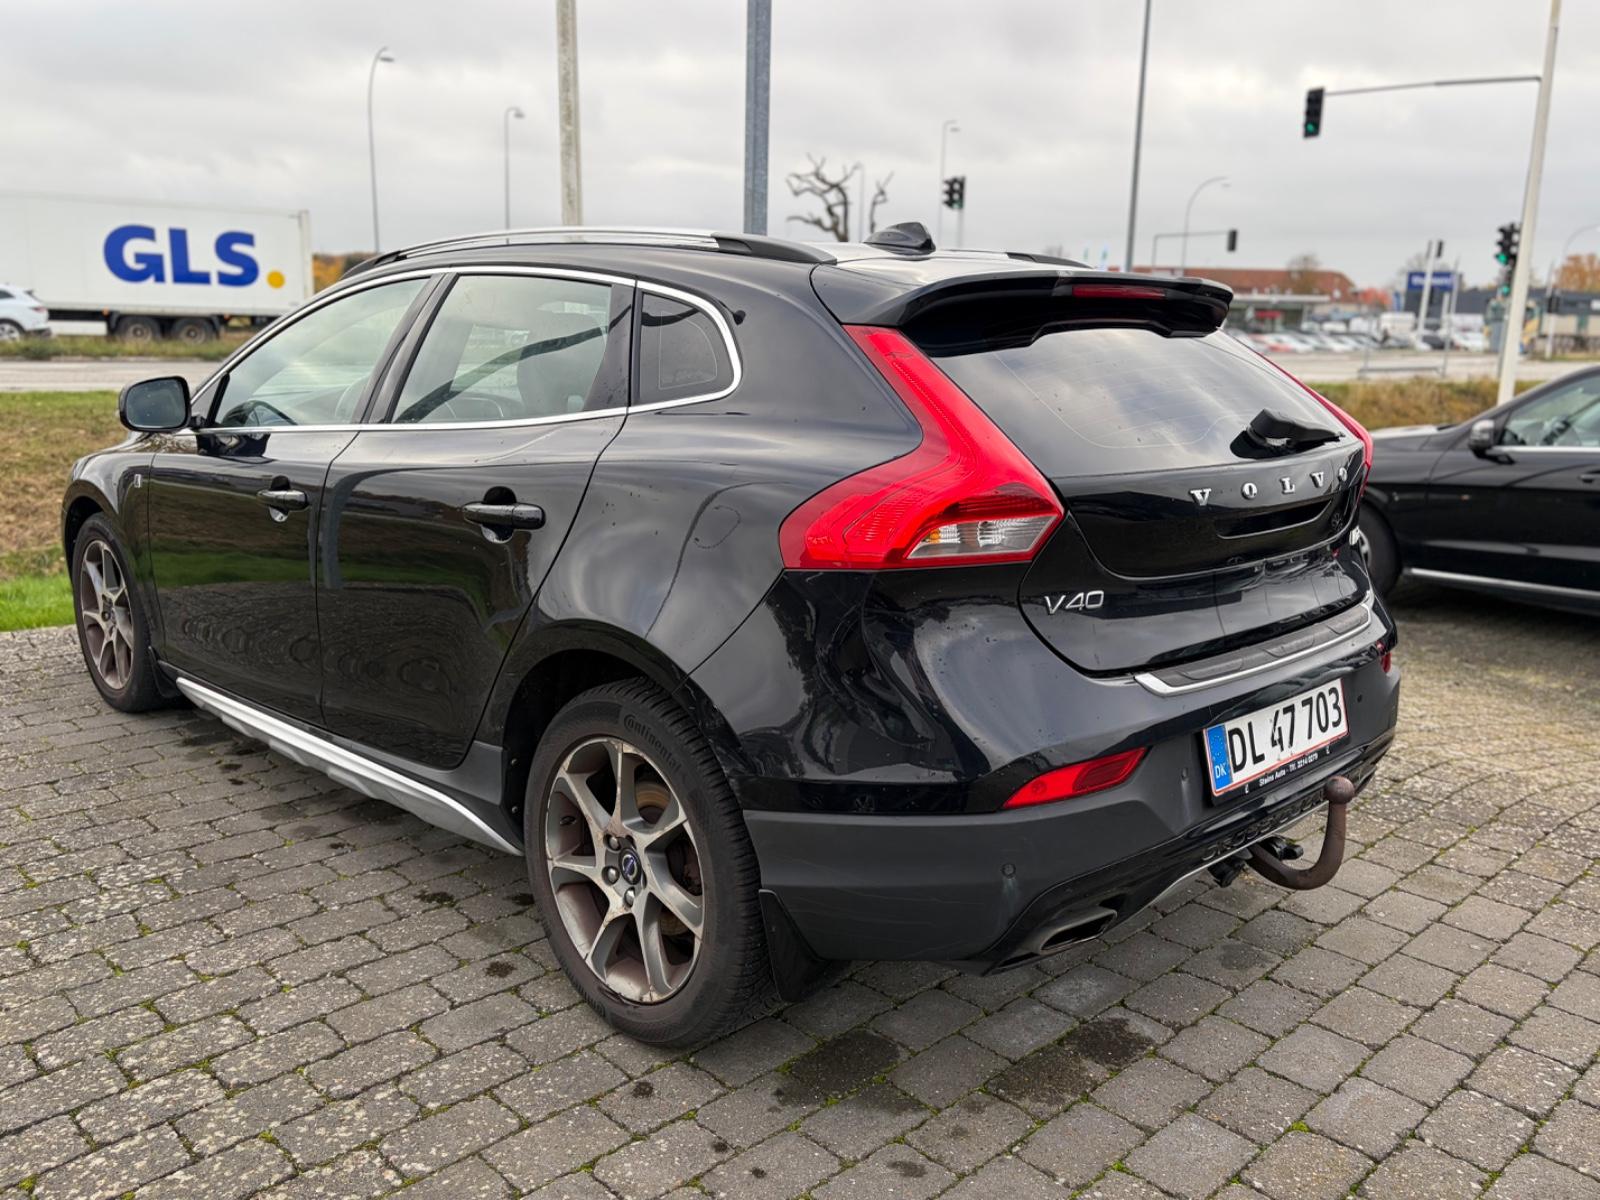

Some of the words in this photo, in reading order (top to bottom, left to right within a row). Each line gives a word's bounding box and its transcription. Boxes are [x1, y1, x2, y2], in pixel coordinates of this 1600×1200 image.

[1189, 467, 1348, 506] VOLVO
[1045, 589, 1104, 615] V40
[1228, 720, 1265, 773] DL
[1270, 704, 1295, 753] 47
[1301, 687, 1342, 740] 703
[1214, 762, 1227, 779] DK
